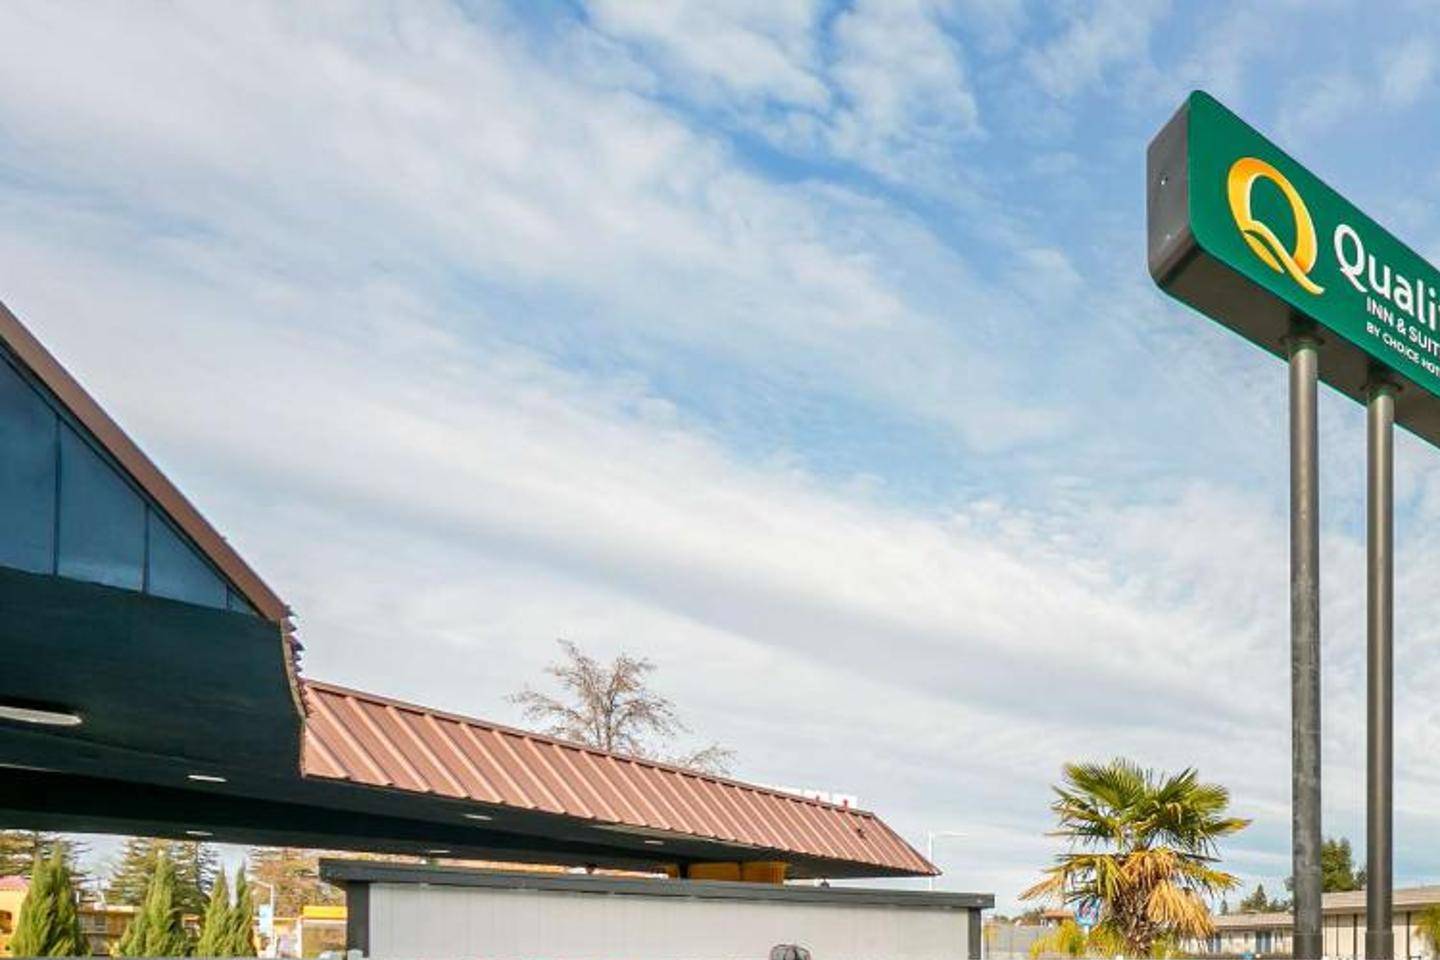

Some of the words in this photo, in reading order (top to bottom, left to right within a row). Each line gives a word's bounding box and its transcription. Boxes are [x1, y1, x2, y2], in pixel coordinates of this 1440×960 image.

[1366, 297, 1394, 327] INN
[1397, 318, 1406, 335] &
[1366, 321, 1381, 338] BY
[1382, 332, 1420, 364] CHOICE
